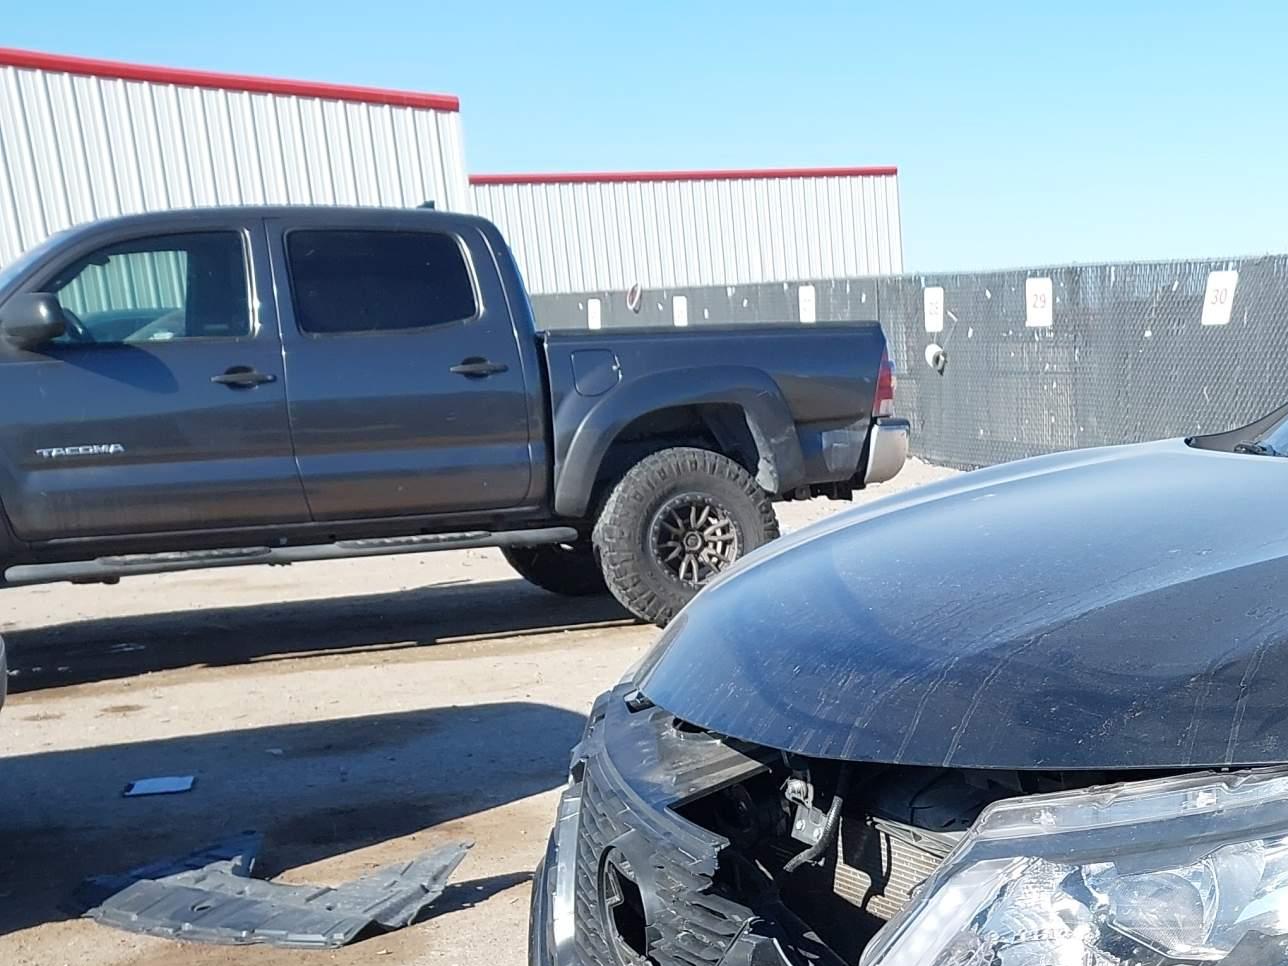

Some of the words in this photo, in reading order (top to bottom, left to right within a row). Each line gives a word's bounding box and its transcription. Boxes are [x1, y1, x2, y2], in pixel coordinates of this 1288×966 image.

[1032, 293, 1047, 309] 29
[1210, 287, 1228, 305] 30
[35, 443, 125, 458] TACOMA
